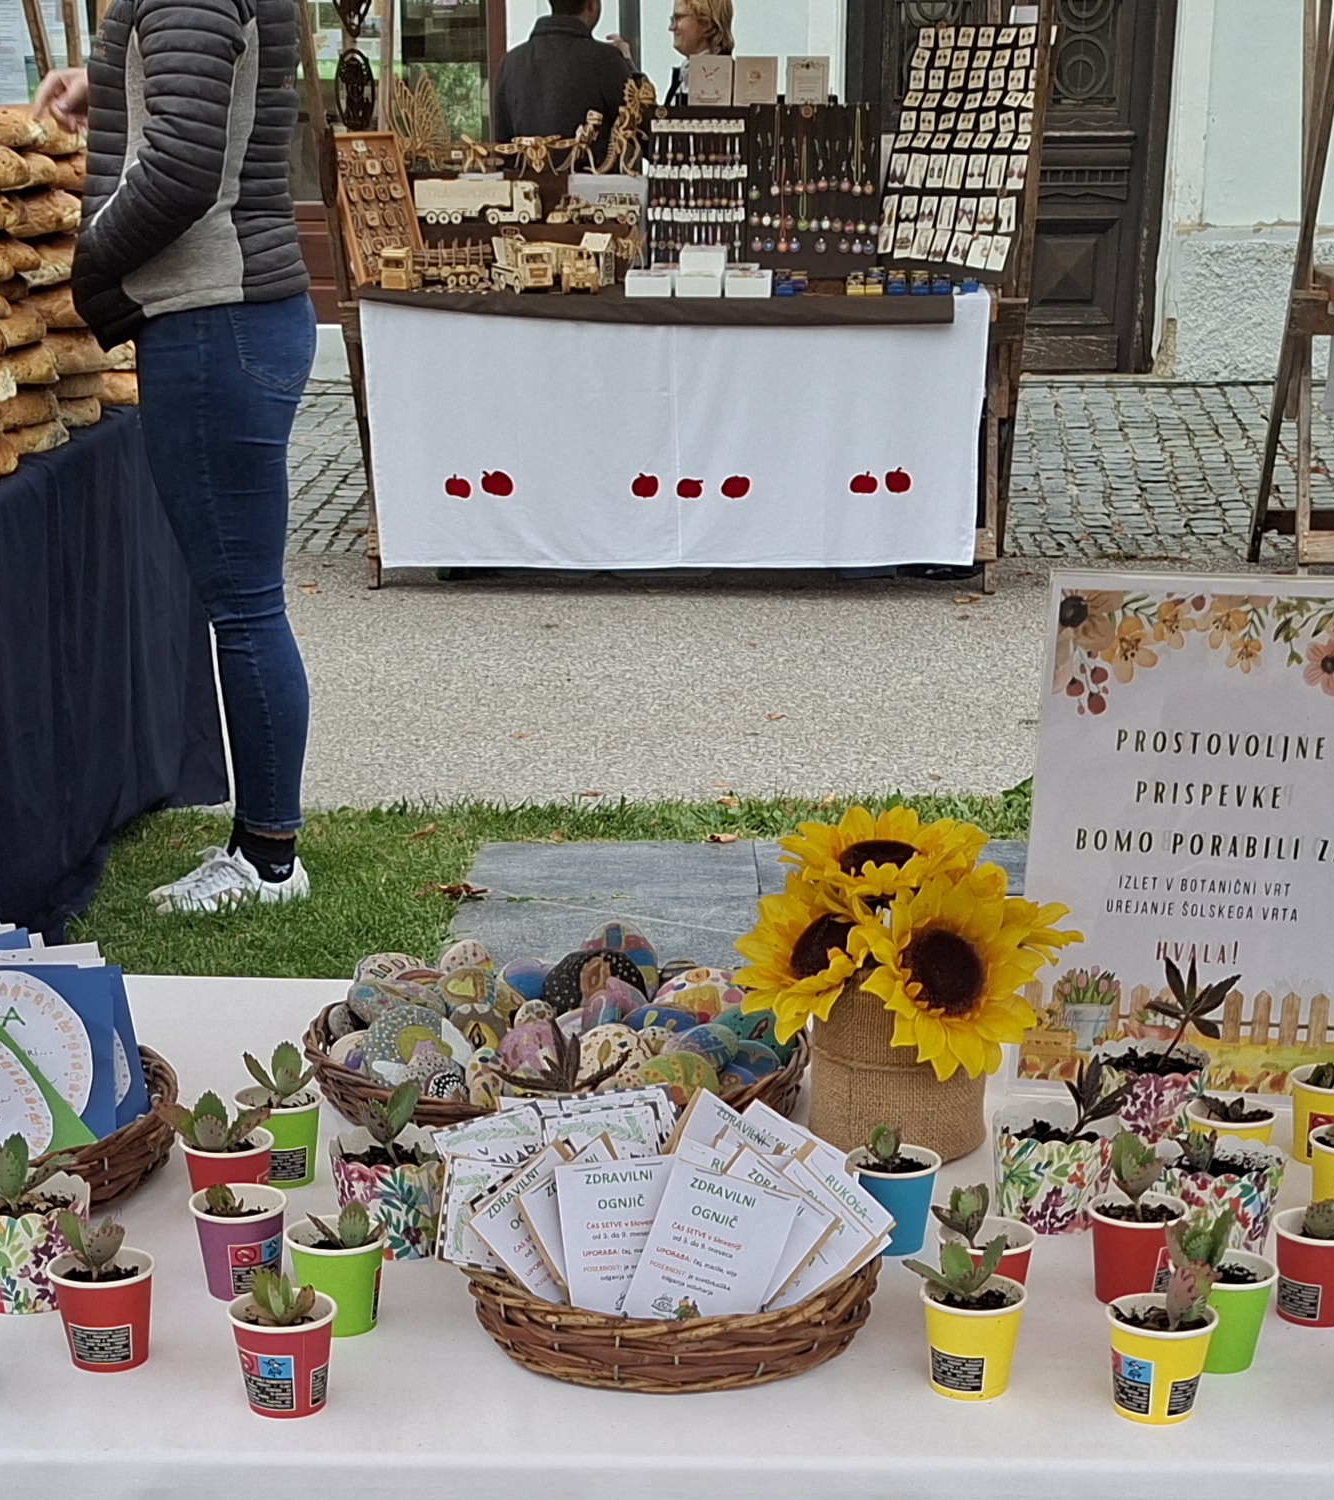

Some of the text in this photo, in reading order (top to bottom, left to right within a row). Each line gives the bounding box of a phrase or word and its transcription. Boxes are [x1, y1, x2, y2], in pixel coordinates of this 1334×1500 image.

[1117, 730, 1326, 762] PROSTOVOLJNE
[1136, 781, 1282, 809] PRISPEVKE
[1076, 828, 1153, 853] BOMO
[1172, 833, 1300, 860] PORABILI
[1119, 875, 1291, 896] IZLET V BOTANIČNI VRT
[1107, 899, 1298, 922] UREJANJE ŠOLSKEGA VRTA
[1156, 941, 1238, 964] HVALA!
[586, 1170, 653, 1185] ZDRAVILNI
[488, 1167, 540, 1219] ZDRAVILNI
[598, 1194, 645, 1209] OGNJIČ
[690, 1177, 756, 1208] ZDRAVILNI
[825, 1174, 868, 1220] RUKOLA
[586, 1221, 600, 1230] ČAS
[601, 1221, 622, 1229] SETVE
[691, 1205, 739, 1229] OGNJIČ
[672, 1221, 685, 1233] ČAS
[686, 1227, 707, 1239] SETVE
[672, 1234, 682, 1242] od
